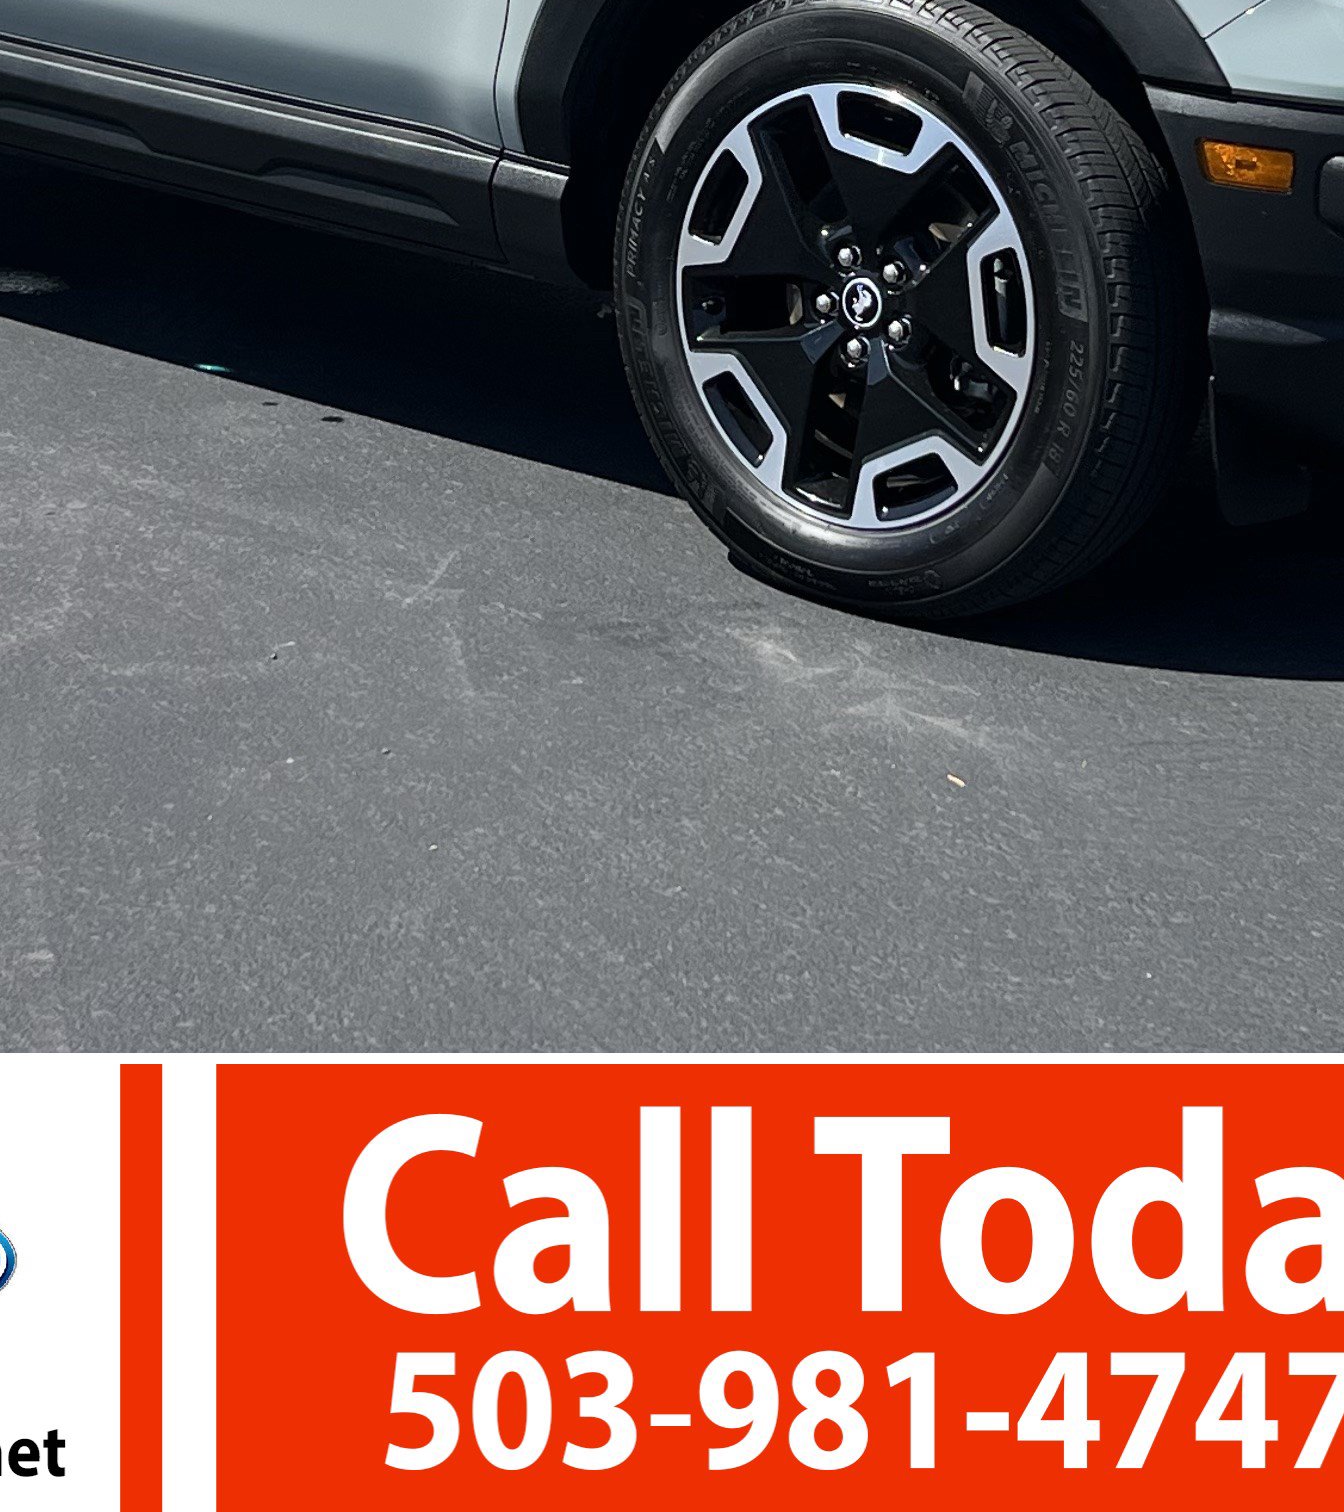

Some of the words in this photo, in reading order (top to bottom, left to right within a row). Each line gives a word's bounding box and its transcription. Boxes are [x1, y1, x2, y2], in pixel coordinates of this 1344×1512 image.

[625, 186, 647, 279] PRIMACY
[1063, 339, 1085, 419] 225/60
[1055, 419, 1071, 439] R
